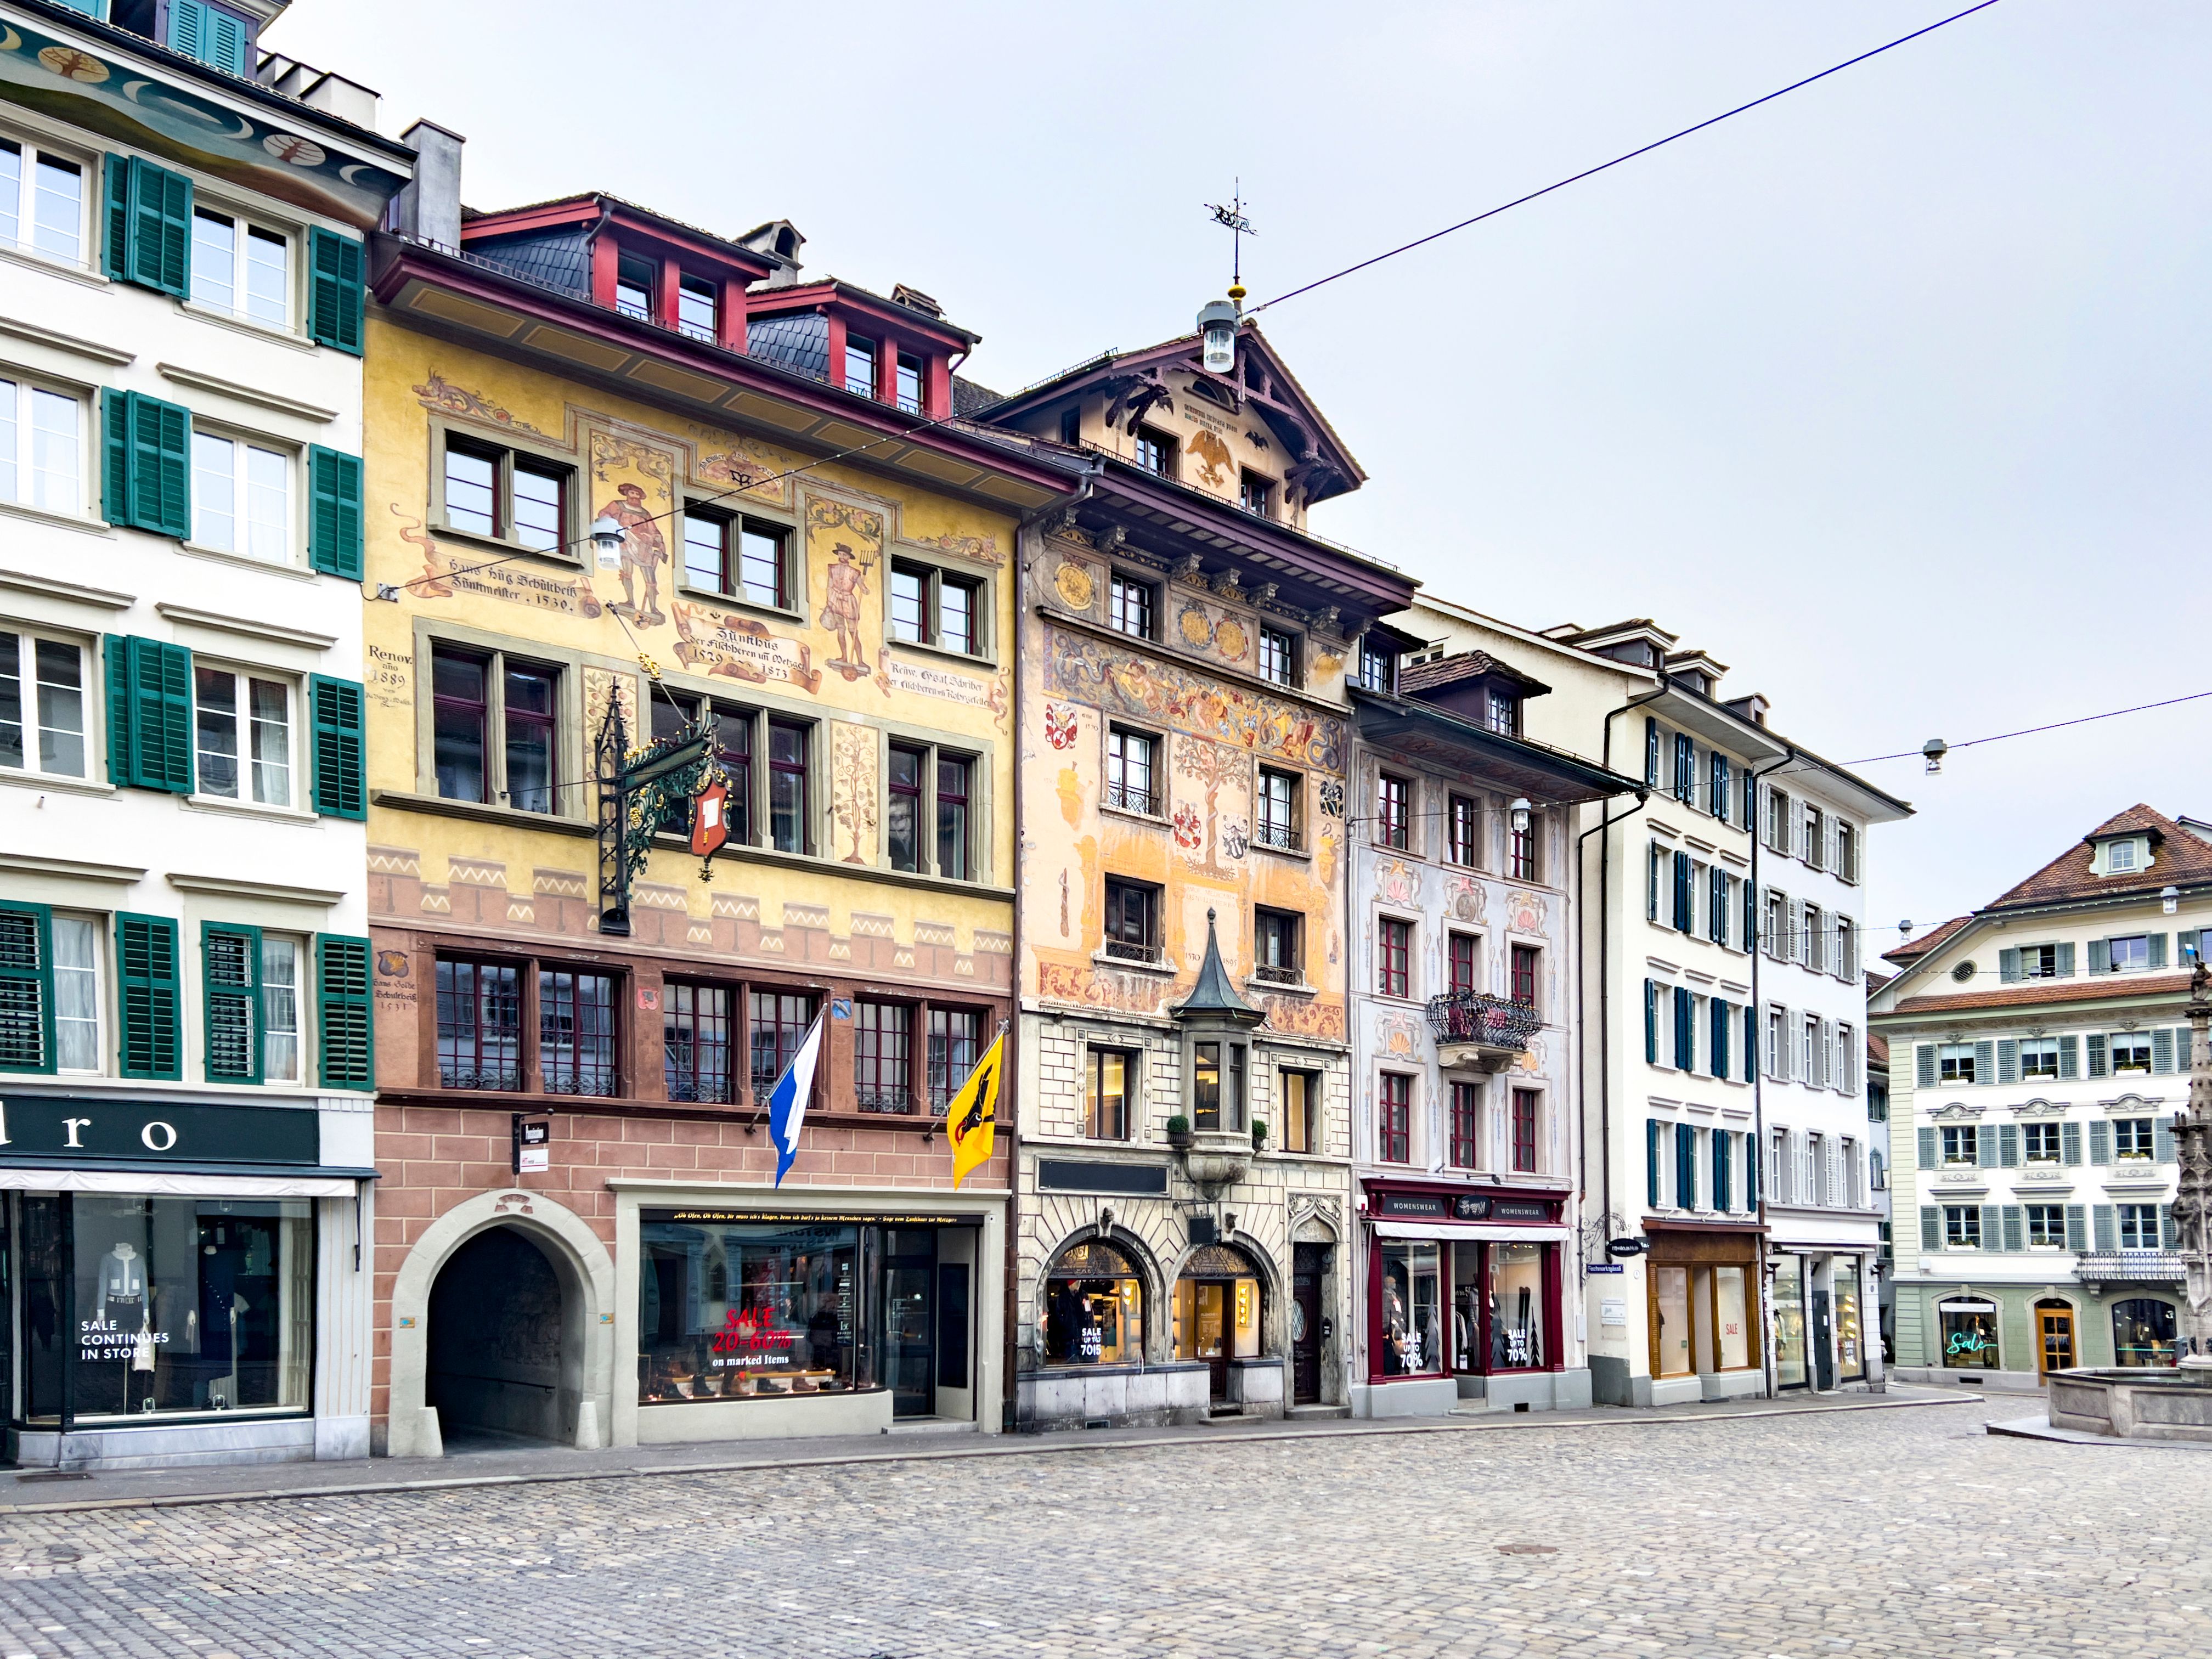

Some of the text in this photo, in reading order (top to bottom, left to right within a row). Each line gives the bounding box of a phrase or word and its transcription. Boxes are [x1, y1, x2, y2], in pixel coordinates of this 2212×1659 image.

[369, 645, 413, 664] Renov.
[689, 646, 723, 665] 1529
[761, 663, 787, 679] 1873
[367, 669, 405, 689] 1889
[1186, 952, 1200, 961] 1530
[1223, 958, 1238, 967] 1895
[1393, 1202, 1436, 1211] WOMENSWEAR
[1501, 1207, 1539, 1216] WOMENSWEAR
[725, 1307, 775, 1330] SALE
[81, 1320, 117, 1331] SALE
[1726, 1323, 1738, 1335] SALE
[1082, 1328, 1101, 1336] SALE
[1401, 1333, 1421, 1343] SALE
[1508, 1329, 1526, 1339] SALE
[81, 1333, 169, 1346] CONTINUES
[712, 1329, 792, 1352] 20-60%
[1946, 1333, 1997, 1353] Sale
[82, 1347, 150, 1360] IN STORE
[1403, 1344, 1419, 1352] UP TO
[1400, 1352, 1423, 1368] 70%
[1507, 1347, 1527, 1362] 70%
[713, 1355, 789, 1367] on marked Items
